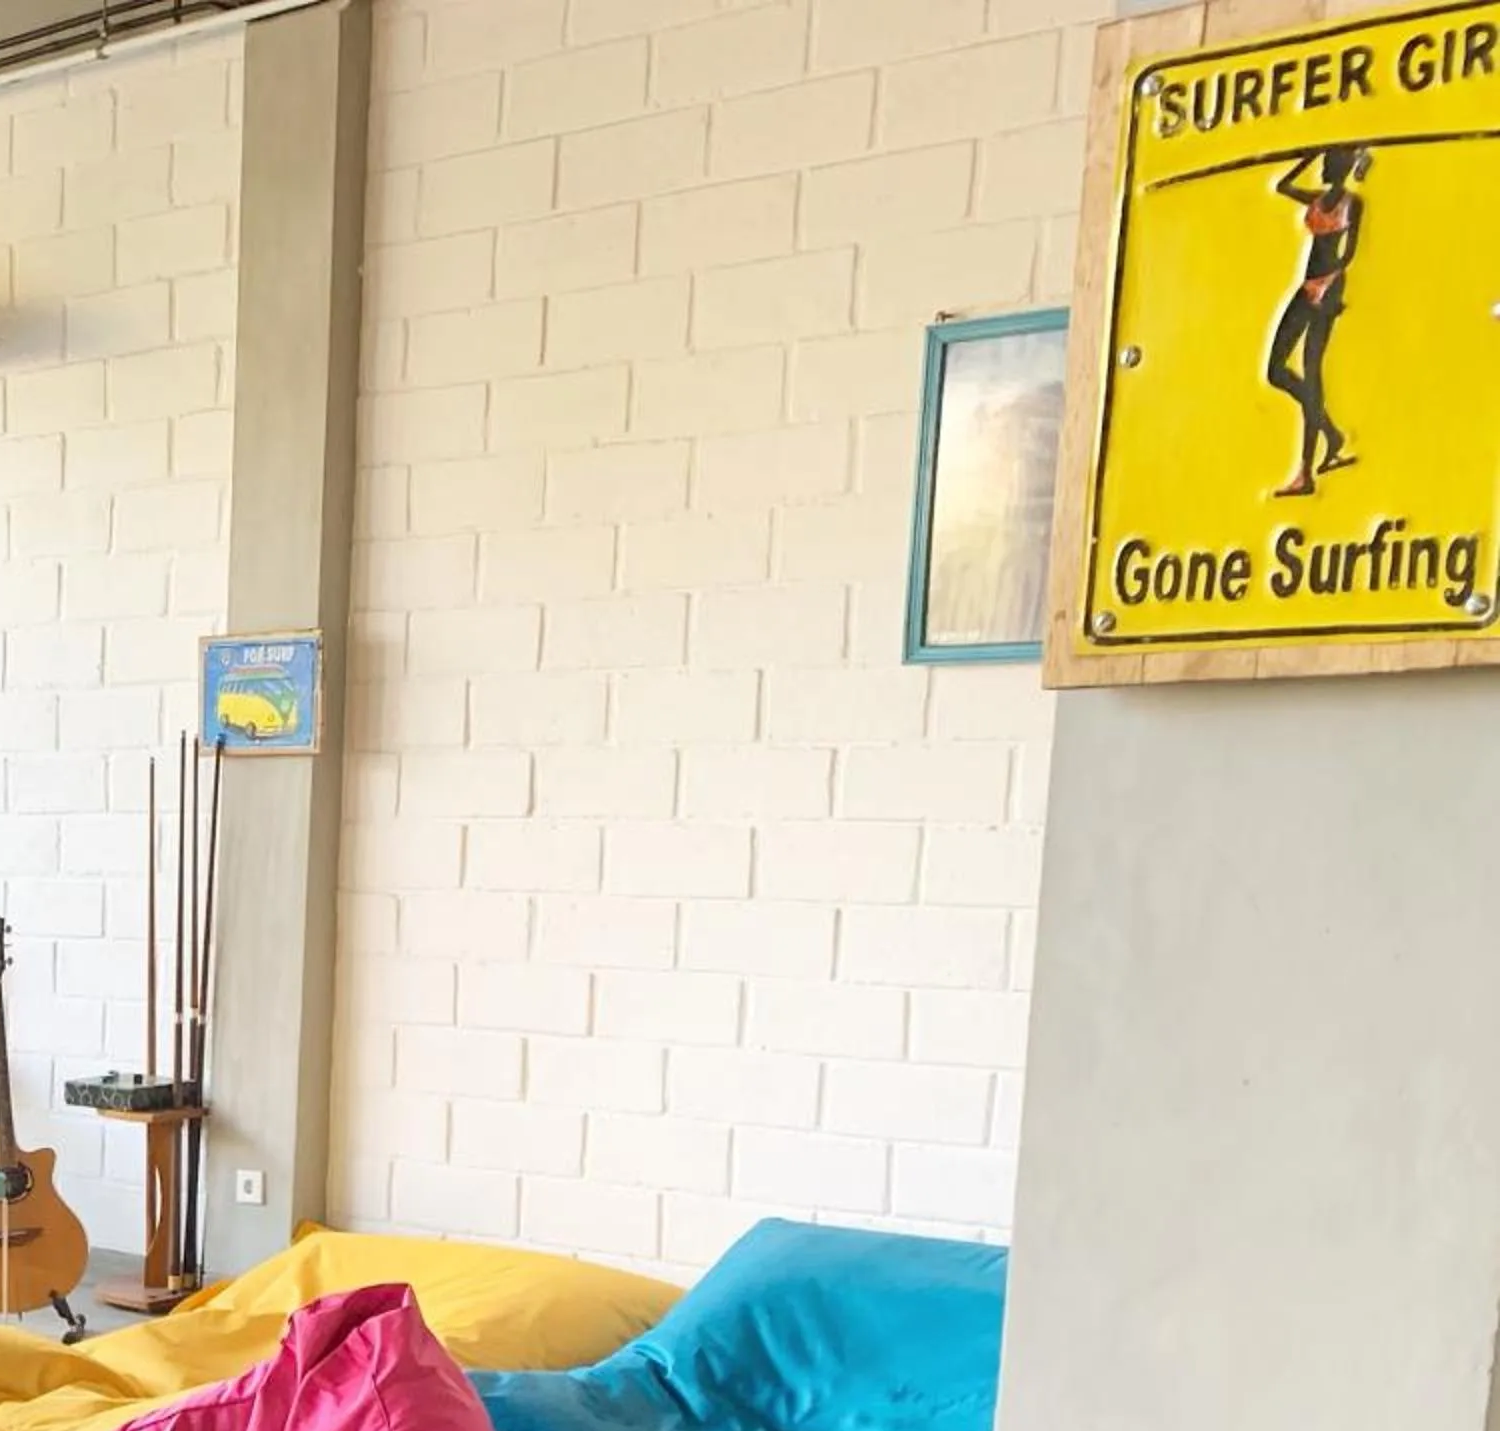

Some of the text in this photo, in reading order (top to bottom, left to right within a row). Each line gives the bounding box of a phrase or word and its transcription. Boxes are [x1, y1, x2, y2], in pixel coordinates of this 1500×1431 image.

[1156, 44, 1375, 140] SURFER
[1115, 518, 1479, 607] Gone Surfing
